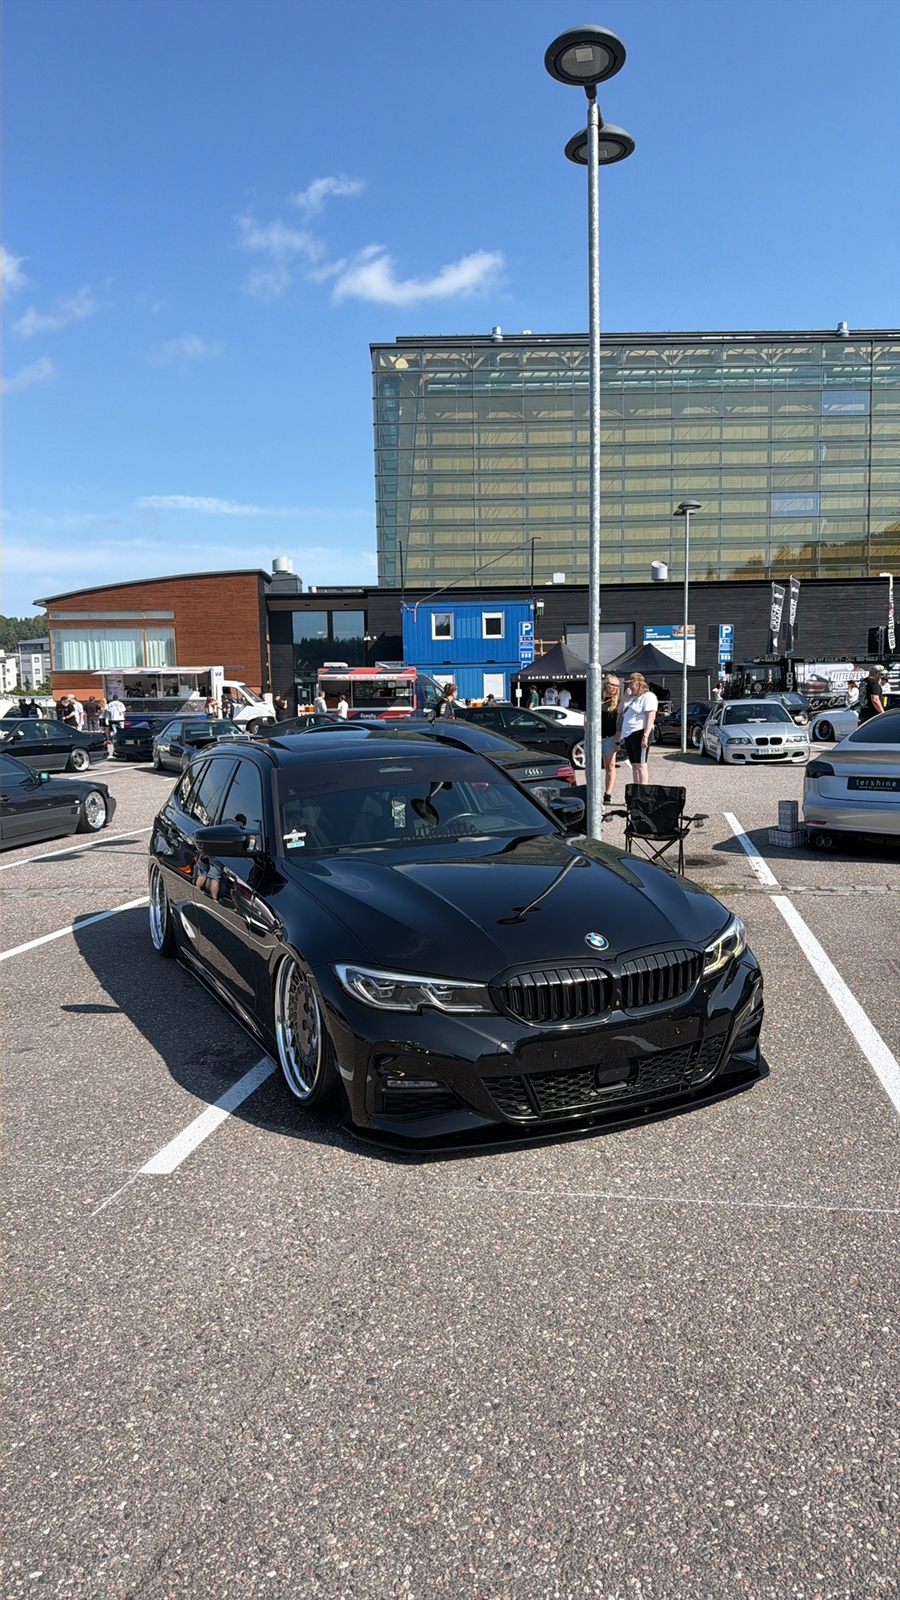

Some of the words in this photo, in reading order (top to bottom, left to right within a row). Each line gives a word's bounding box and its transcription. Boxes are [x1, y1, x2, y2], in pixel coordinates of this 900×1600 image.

[522, 623, 531, 635] P
[723, 626, 731, 637] P
[856, 779, 897, 787] tershine
